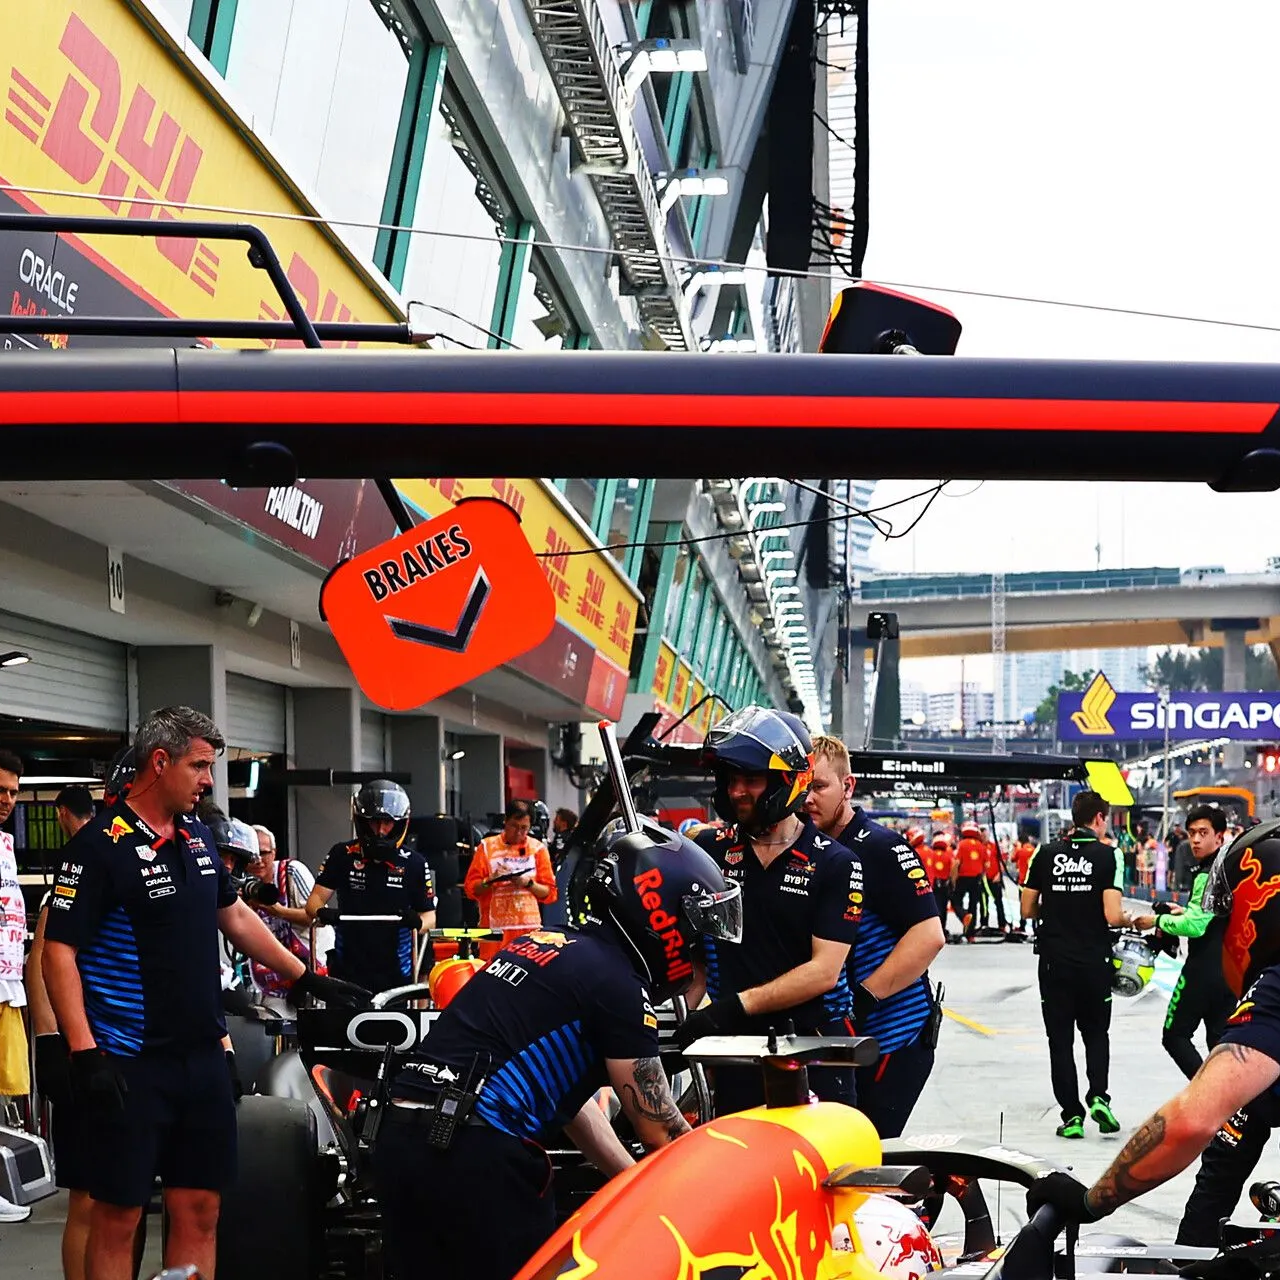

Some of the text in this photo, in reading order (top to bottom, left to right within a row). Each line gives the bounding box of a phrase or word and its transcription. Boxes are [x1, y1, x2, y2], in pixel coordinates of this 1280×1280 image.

[19, 248, 79, 314] ORACLE
[265, 486, 324, 540] HAMILTON
[363, 525, 472, 602] BRAKES
[110, 561, 122, 600] 10
[882, 760, 945, 773] Einhell
[135, 819, 155, 840] zoom
[1053, 854, 1092, 875] Stake
[146, 877, 172, 887] ORACLE
[780, 885, 809, 896] HONDA
[633, 868, 679, 932] Red
